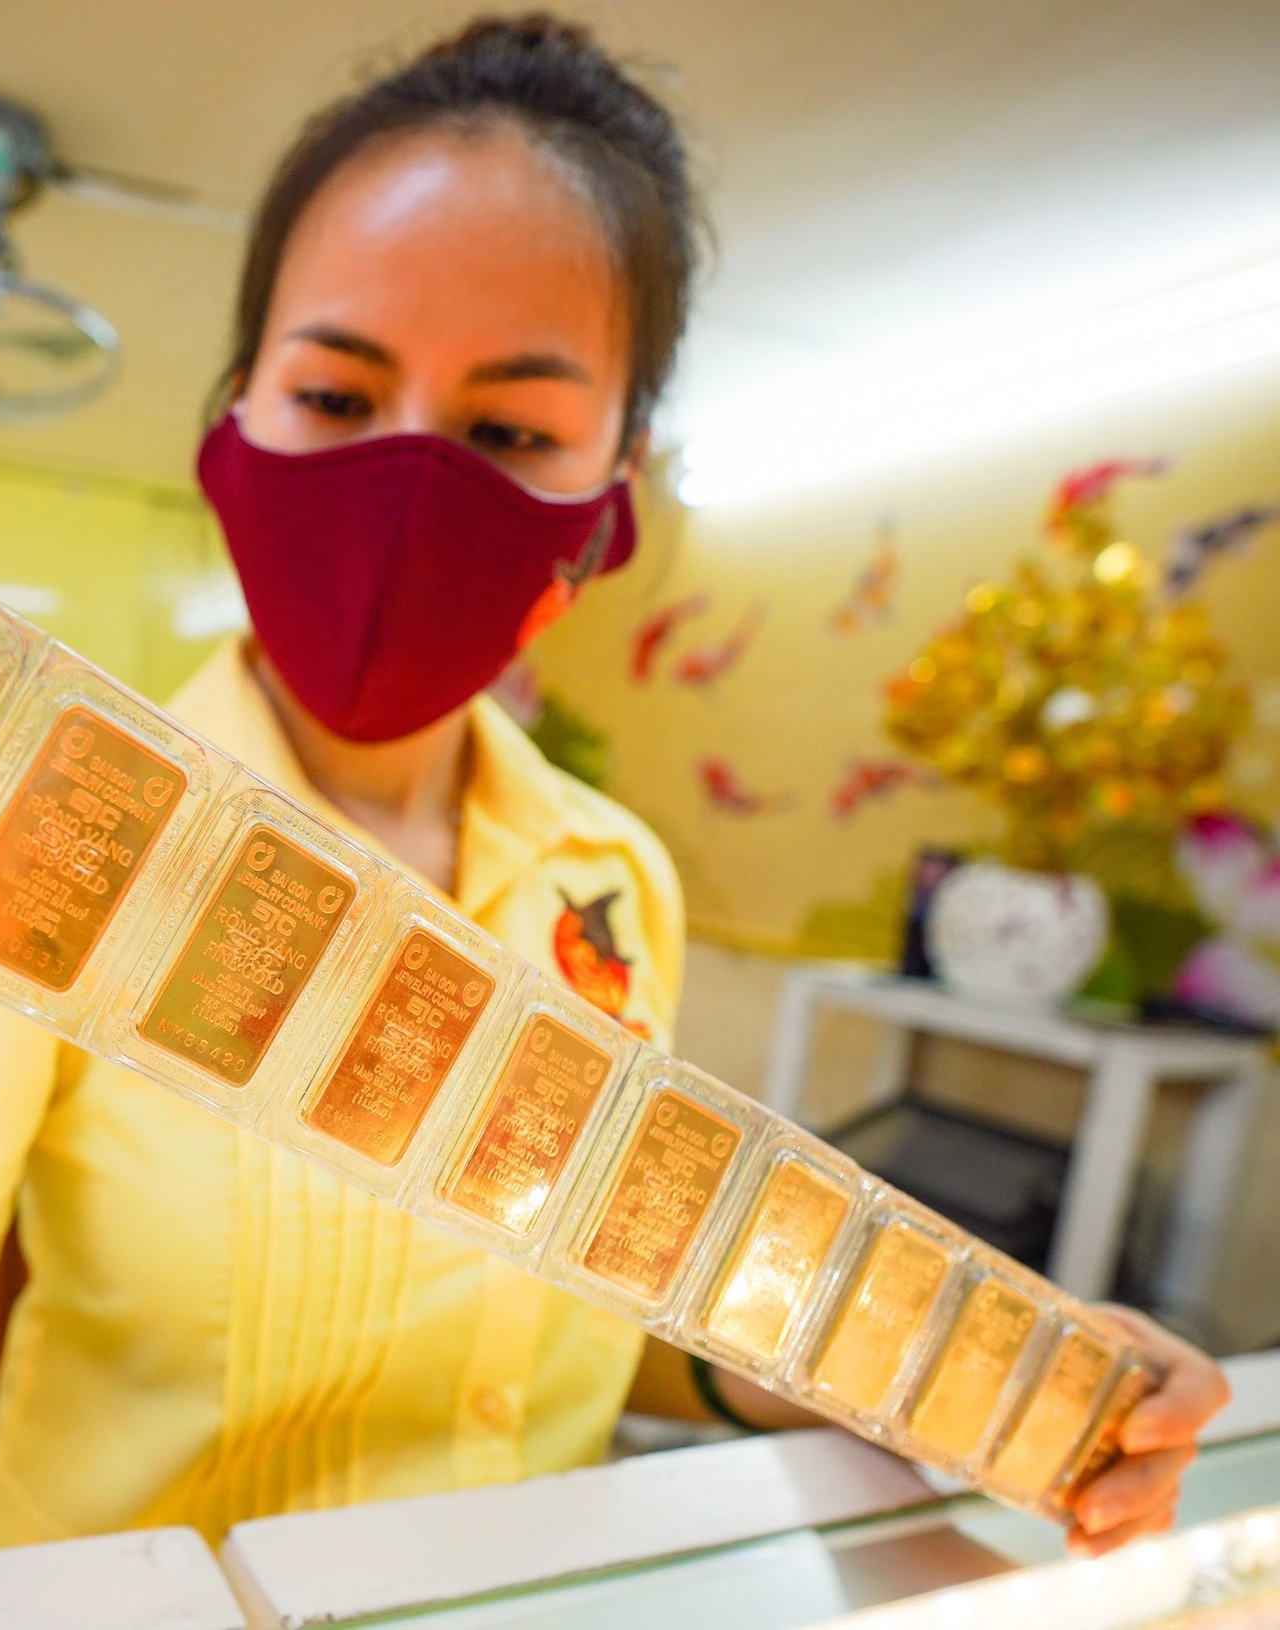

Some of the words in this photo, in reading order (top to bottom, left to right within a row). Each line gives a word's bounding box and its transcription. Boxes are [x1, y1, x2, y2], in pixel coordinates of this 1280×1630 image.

[87, 753, 112, 778] SAI
[106, 765, 137, 793] GON
[65, 785, 123, 832] SJC
[99, 782, 156, 826] COMPANY
[78, 825, 135, 868] VÀNG
[55, 855, 112, 898] GOLD
[269, 868, 290, 888] SAI
[285, 878, 312, 902] GON
[235, 867, 284, 904] JEWELRY
[279, 894, 328, 931] COMPANY
[249, 897, 298, 937] SJC
[213, 905, 263, 943] RỒNG
[260, 933, 308, 970] VÀNG
[202, 939, 242, 972] FINE
[238, 961, 286, 997] GOLD
[215, 972, 242, 993] CÔNG
[422, 967, 441, 984] SAI
[436, 975, 459, 996] GON
[190, 972, 217, 993] VÀNG
[245, 1000, 268, 1021] QUÝ
[393, 967, 435, 999] JEWELRY
[429, 990, 471, 1023] COMPANY
[404, 993, 447, 1029] SJC
[350, 1062, 375, 1082] VÀNG
[531, 1074, 569, 1107] SJC
[660, 1148, 698, 1179] SJC
